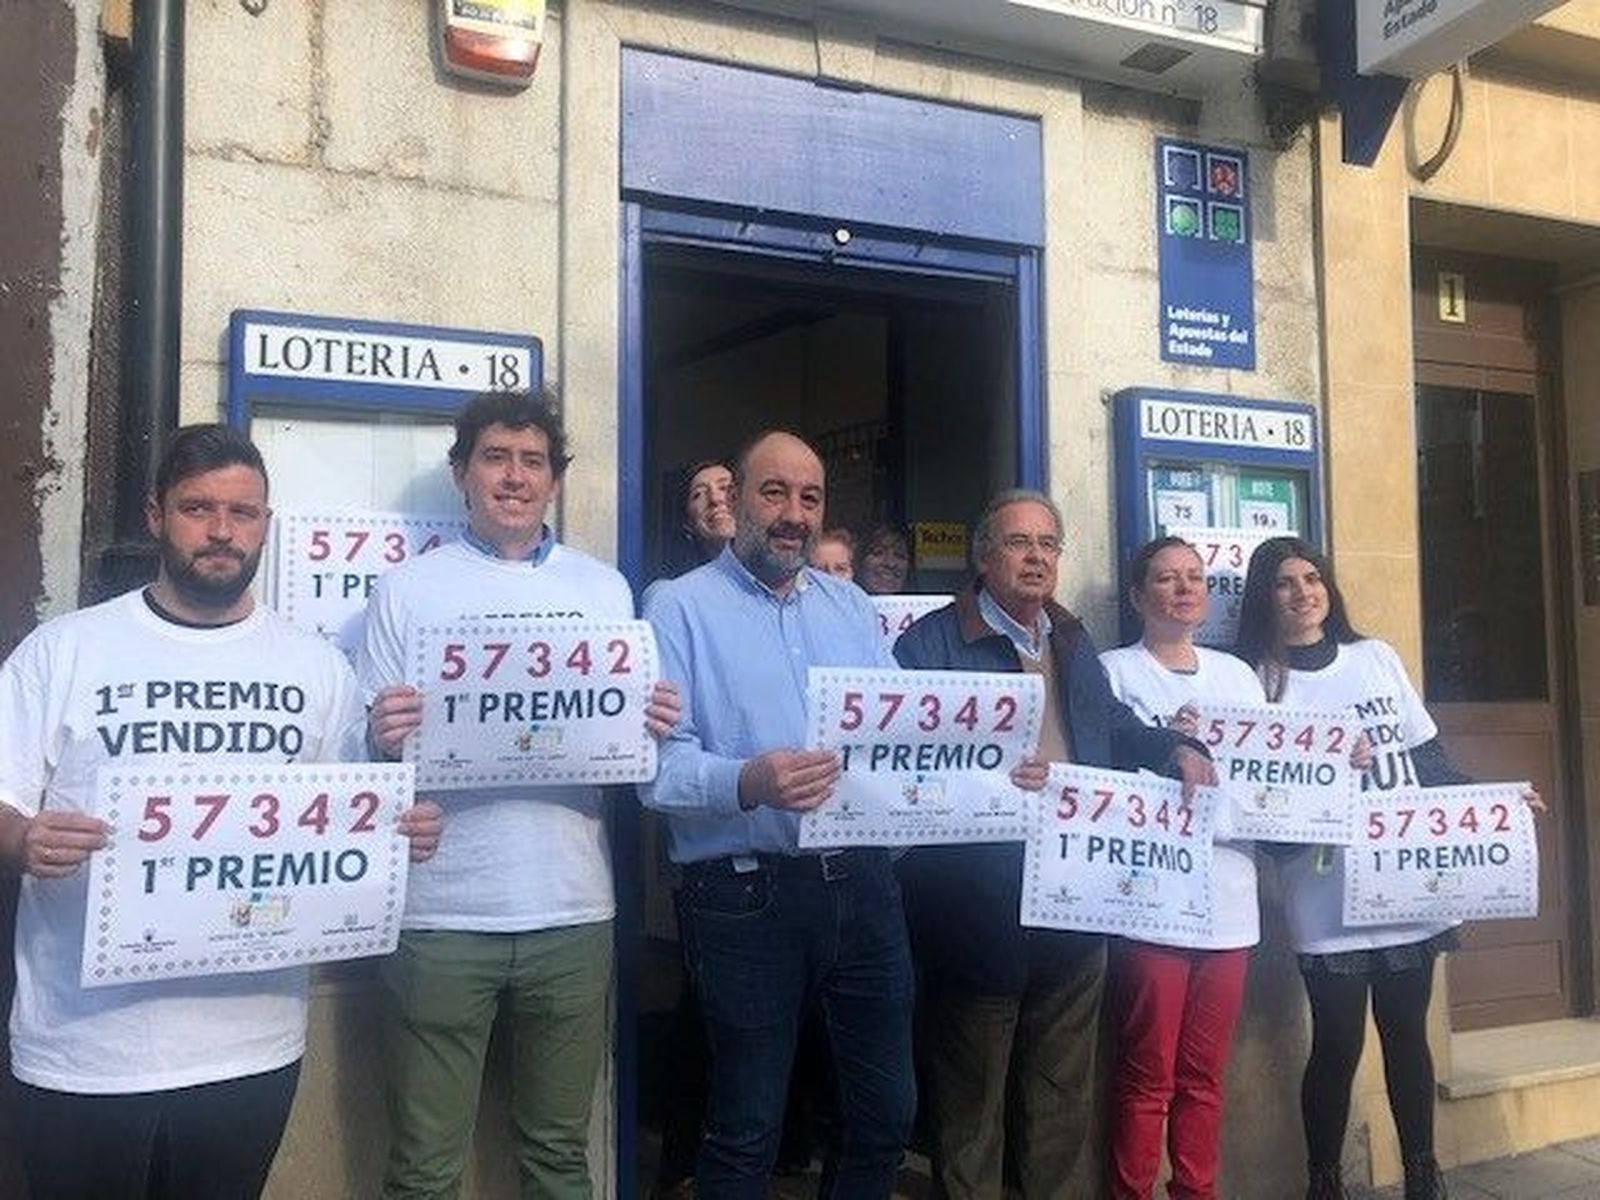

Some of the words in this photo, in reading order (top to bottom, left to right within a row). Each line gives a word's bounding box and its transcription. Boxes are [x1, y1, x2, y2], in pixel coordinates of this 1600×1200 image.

[1194, 5, 1219, 33] 18
[1383, 0, 1438, 40] Estado
[1168, 322, 1228, 341] Apuestas
[1229, 329, 1248, 344] del
[1221, 314, 1230, 328] y
[258, 333, 443, 381] LOTERIA
[485, 352, 520, 388] 18
[1168, 339, 1213, 358] Estado
[1147, 405, 1257, 441] LOTERIA
[1284, 419, 1306, 446] 18
[1206, 575, 1243, 596] PRE
[440, 639, 631, 682] 57342
[145, 681, 305, 714] PREMIO
[479, 687, 626, 723] PREMIO
[839, 692, 1018, 732] 57342
[97, 721, 304, 757] VENDIDO
[1206, 719, 1345, 754] 57342
[871, 743, 1004, 771] PREMIO
[1229, 758, 1337, 786] PREMIO
[138, 791, 381, 842] 57342
[1057, 786, 1193, 837] 57342
[1367, 803, 1511, 840] 57342
[186, 849, 369, 892] PREMIO
[1086, 835, 1193, 874] PREMIO
[1397, 843, 1510, 871] PREMIO
